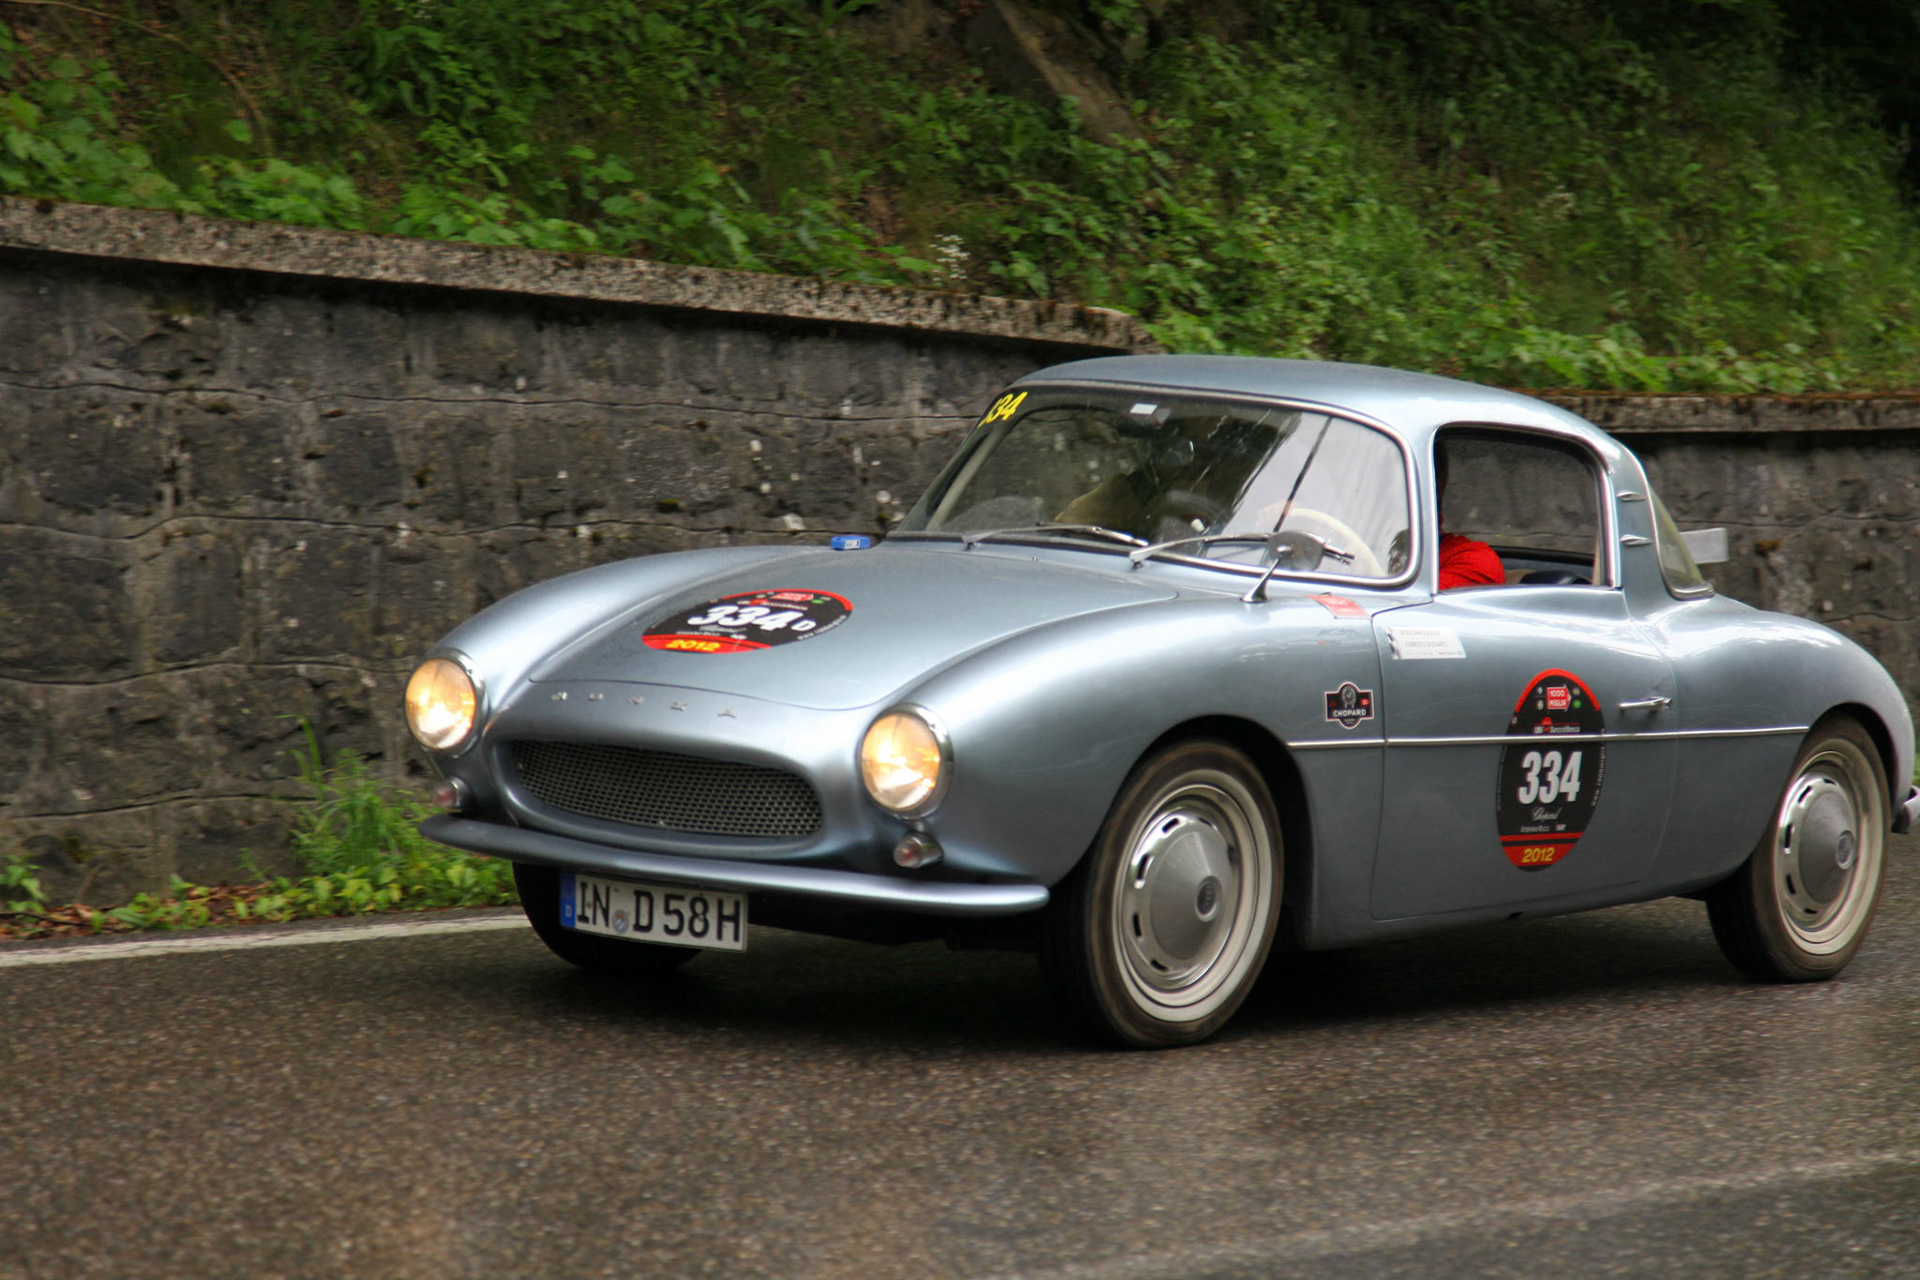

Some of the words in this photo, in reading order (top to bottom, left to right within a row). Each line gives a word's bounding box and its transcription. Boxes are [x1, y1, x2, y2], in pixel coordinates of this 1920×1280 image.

[687, 604, 804, 631] 334
[665, 639, 721, 652] 2012
[1549, 689, 1566, 698] 1000
[1333, 709, 1367, 718] CHOPARD
[1517, 751, 1583, 805] 334
[1521, 847, 1556, 863] 2012
[577, 881, 611, 928] IN
